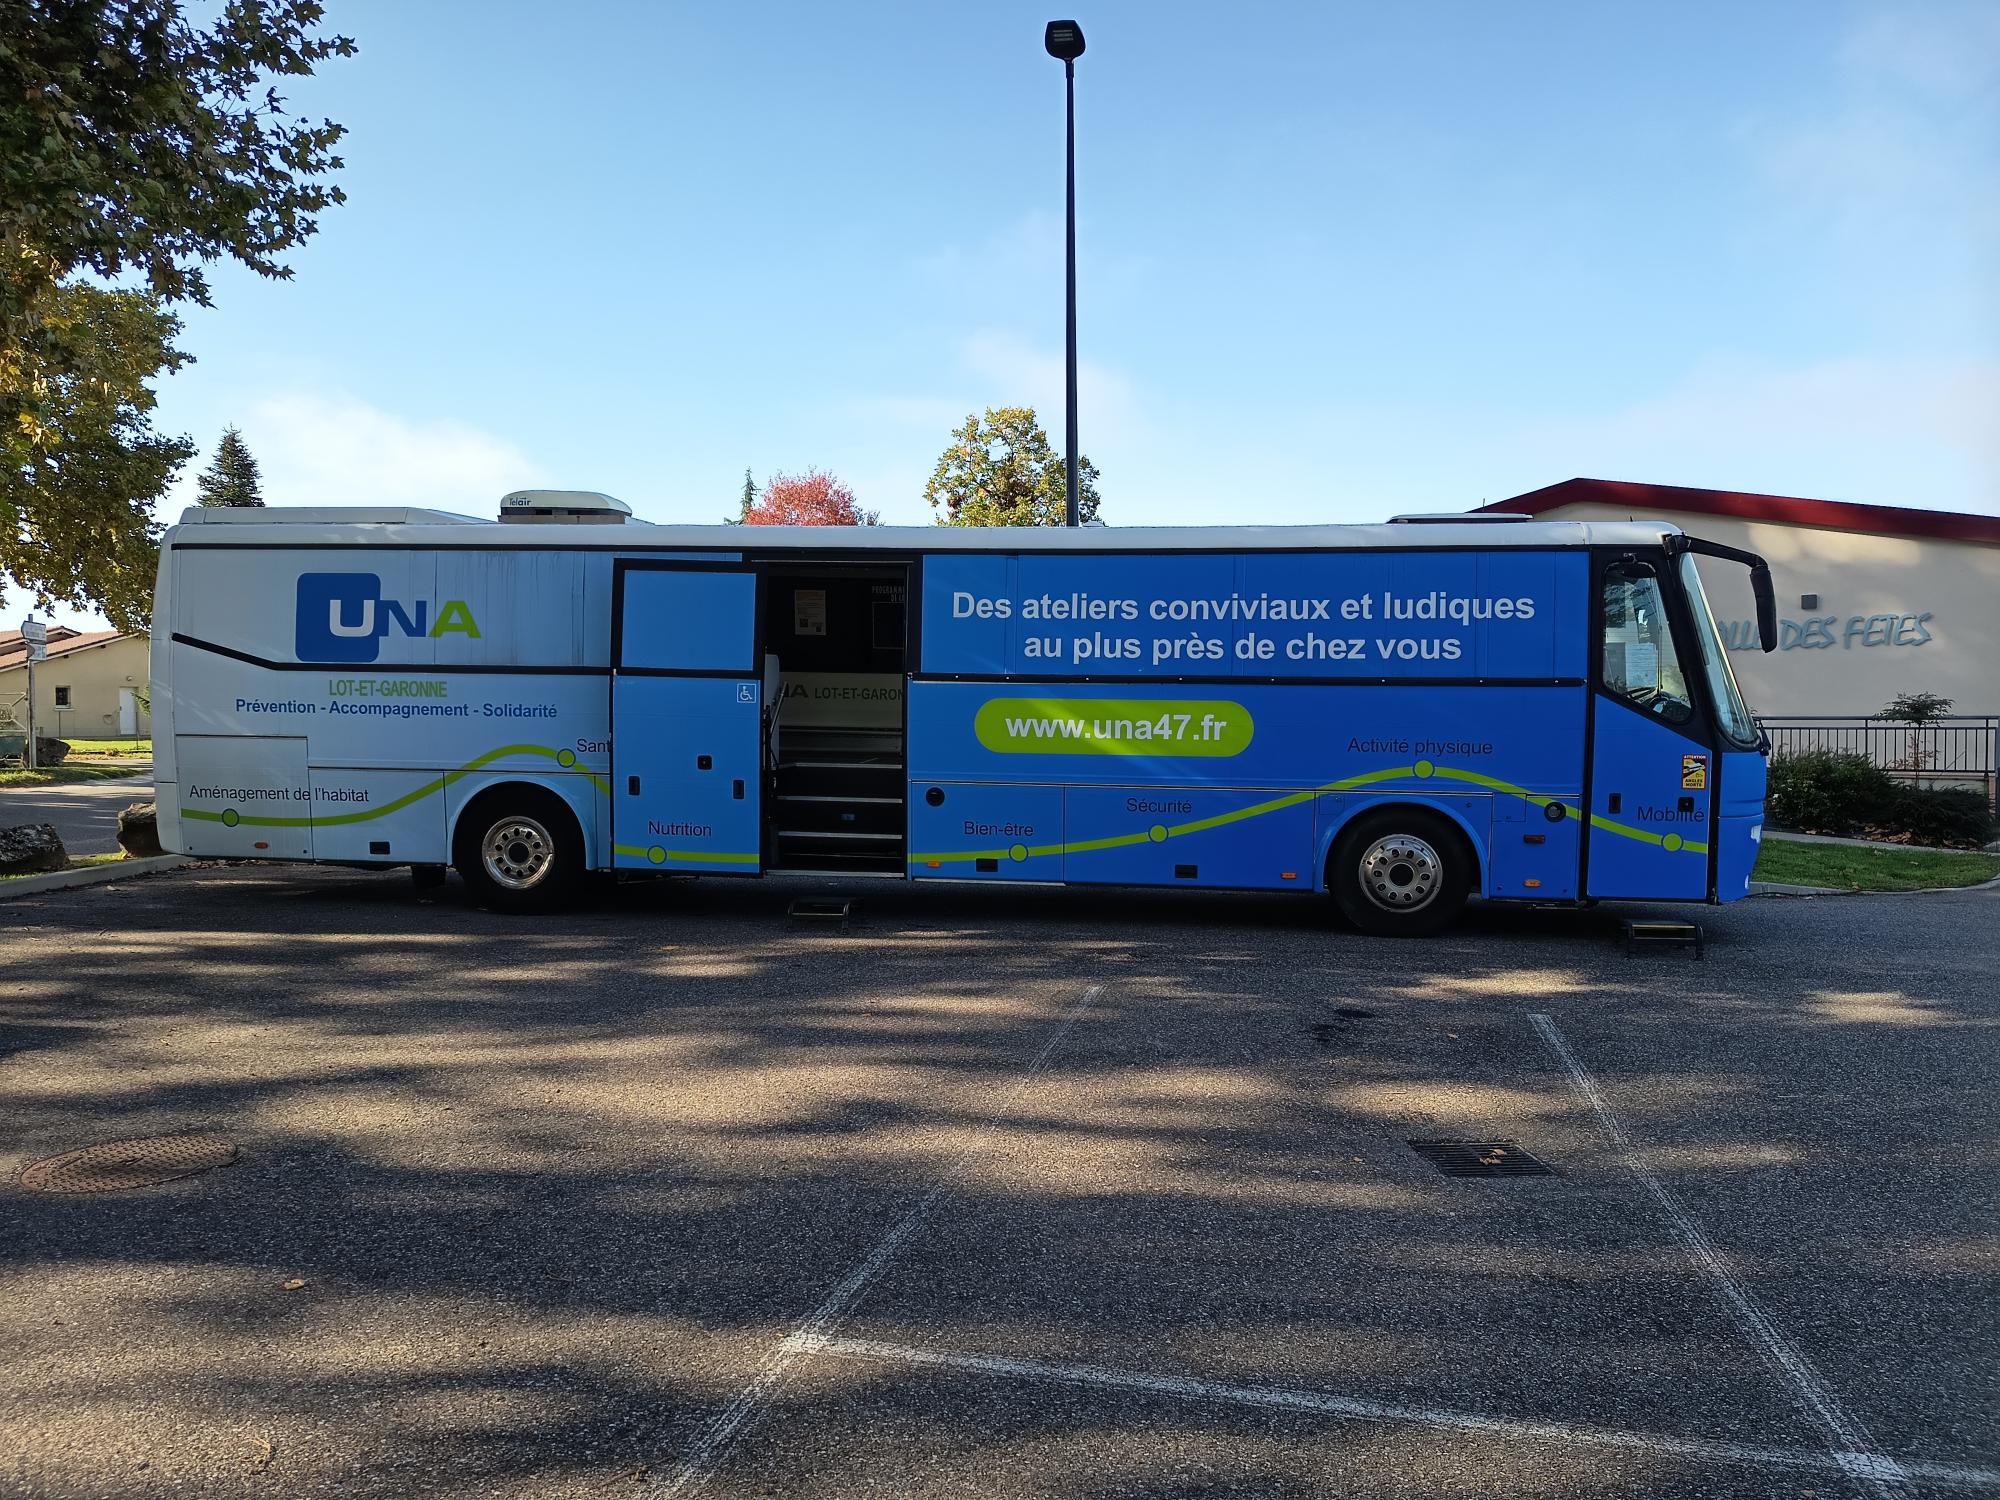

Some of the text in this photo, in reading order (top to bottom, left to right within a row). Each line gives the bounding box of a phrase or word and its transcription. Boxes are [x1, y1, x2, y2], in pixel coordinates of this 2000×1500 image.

[329, 599, 482, 638] UNA
[952, 591, 1535, 626] Des ateliers conviviaux et ludiques
[1780, 616, 1837, 650] DES
[1843, 611, 1935, 649] FETES
[1024, 631, 1462, 665] au plus près de chez vous
[328, 680, 448, 697] LOT-ET-GARONNE
[235, 699, 316, 714] Prévention
[329, 701, 469, 719] Accompagnement
[482, 703, 558, 718] Solidarité
[1005, 714, 1228, 741] www.una47.fr
[1347, 737, 1493, 757] Activité physique
[190, 785, 290, 802] Aménagement
[293, 787, 311, 801] de
[1126, 797, 1192, 813] Sécurité
[648, 820, 712, 837] Nutrition
[964, 821, 1034, 836] Bien-être
